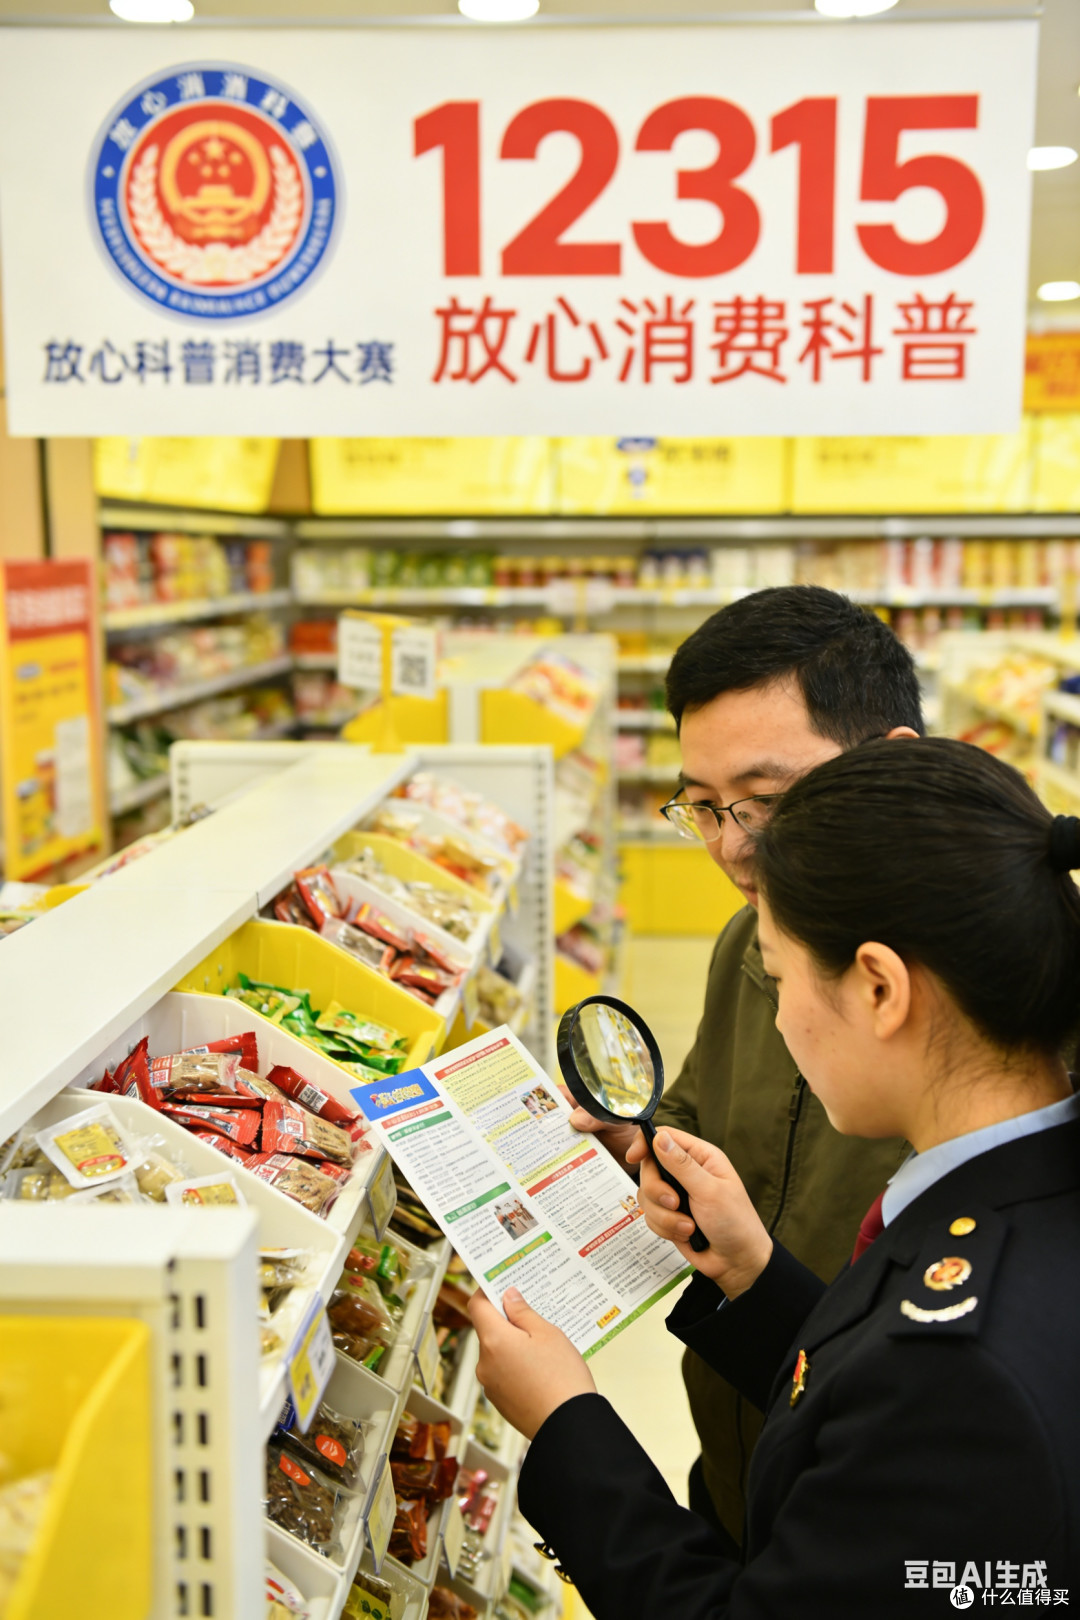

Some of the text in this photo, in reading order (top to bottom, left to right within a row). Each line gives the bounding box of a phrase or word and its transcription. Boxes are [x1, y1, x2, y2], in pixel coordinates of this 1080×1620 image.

[413, 94, 986, 279] 12315
[43, 340, 396, 387] 放心科普消费大赛
[432, 293, 977, 386] 放心消费科普
